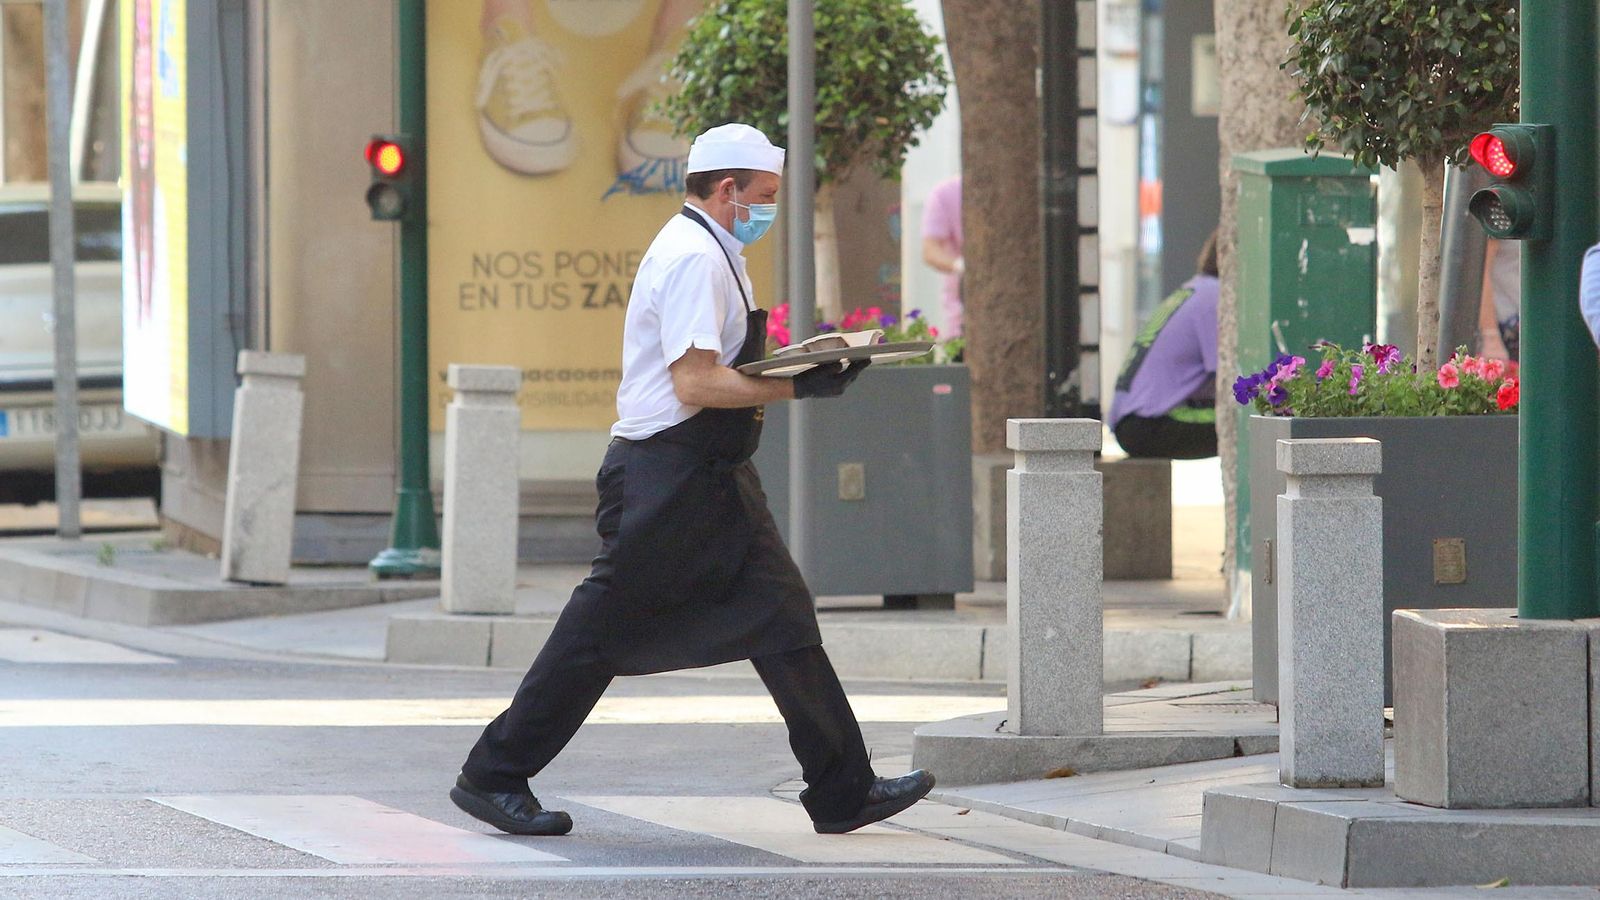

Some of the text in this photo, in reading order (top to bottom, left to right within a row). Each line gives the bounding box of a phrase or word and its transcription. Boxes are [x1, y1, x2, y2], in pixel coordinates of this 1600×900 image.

[472, 251, 640, 279] NOS PONE
[458, 282, 632, 311] EN TUS ZA
